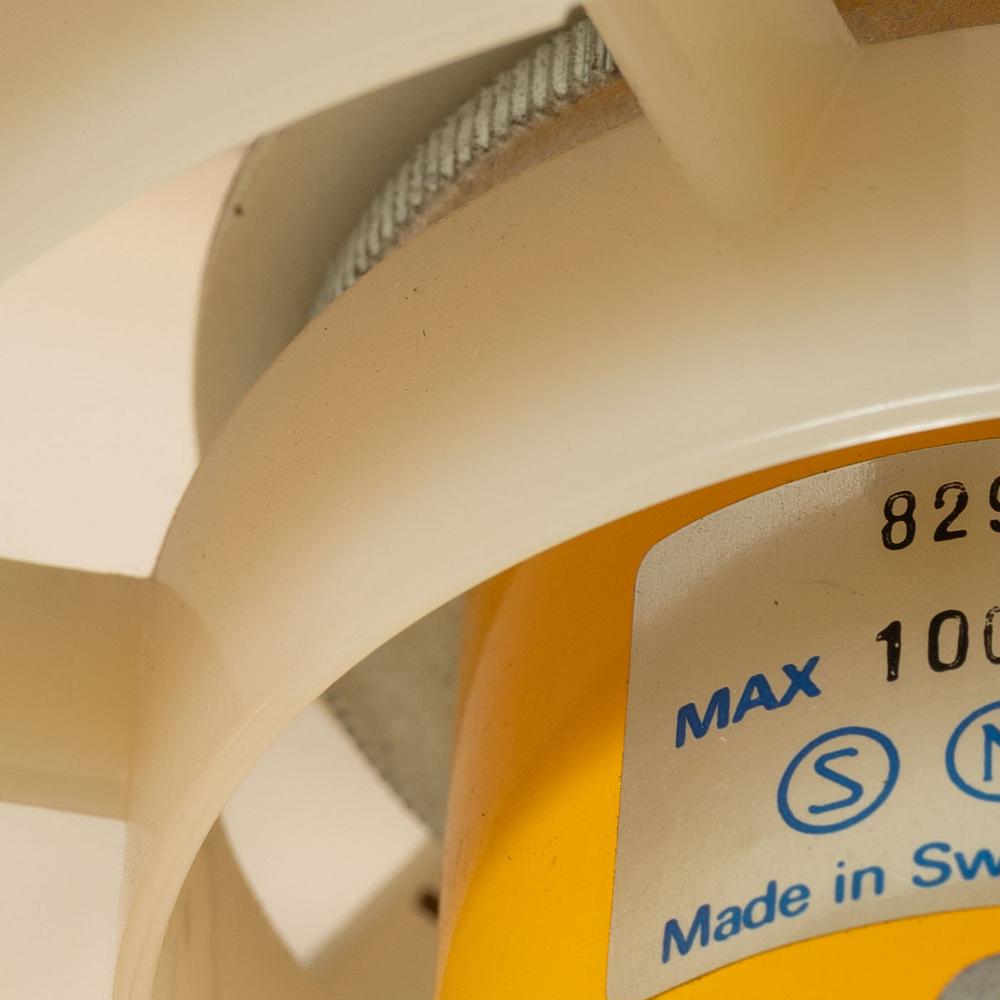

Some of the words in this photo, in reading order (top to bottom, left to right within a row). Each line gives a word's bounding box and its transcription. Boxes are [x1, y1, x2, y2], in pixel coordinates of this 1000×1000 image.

[676, 656, 821, 748] MAX
[808, 747, 864, 814] S
[661, 880, 810, 963] Made
[834, 861, 885, 903] in
